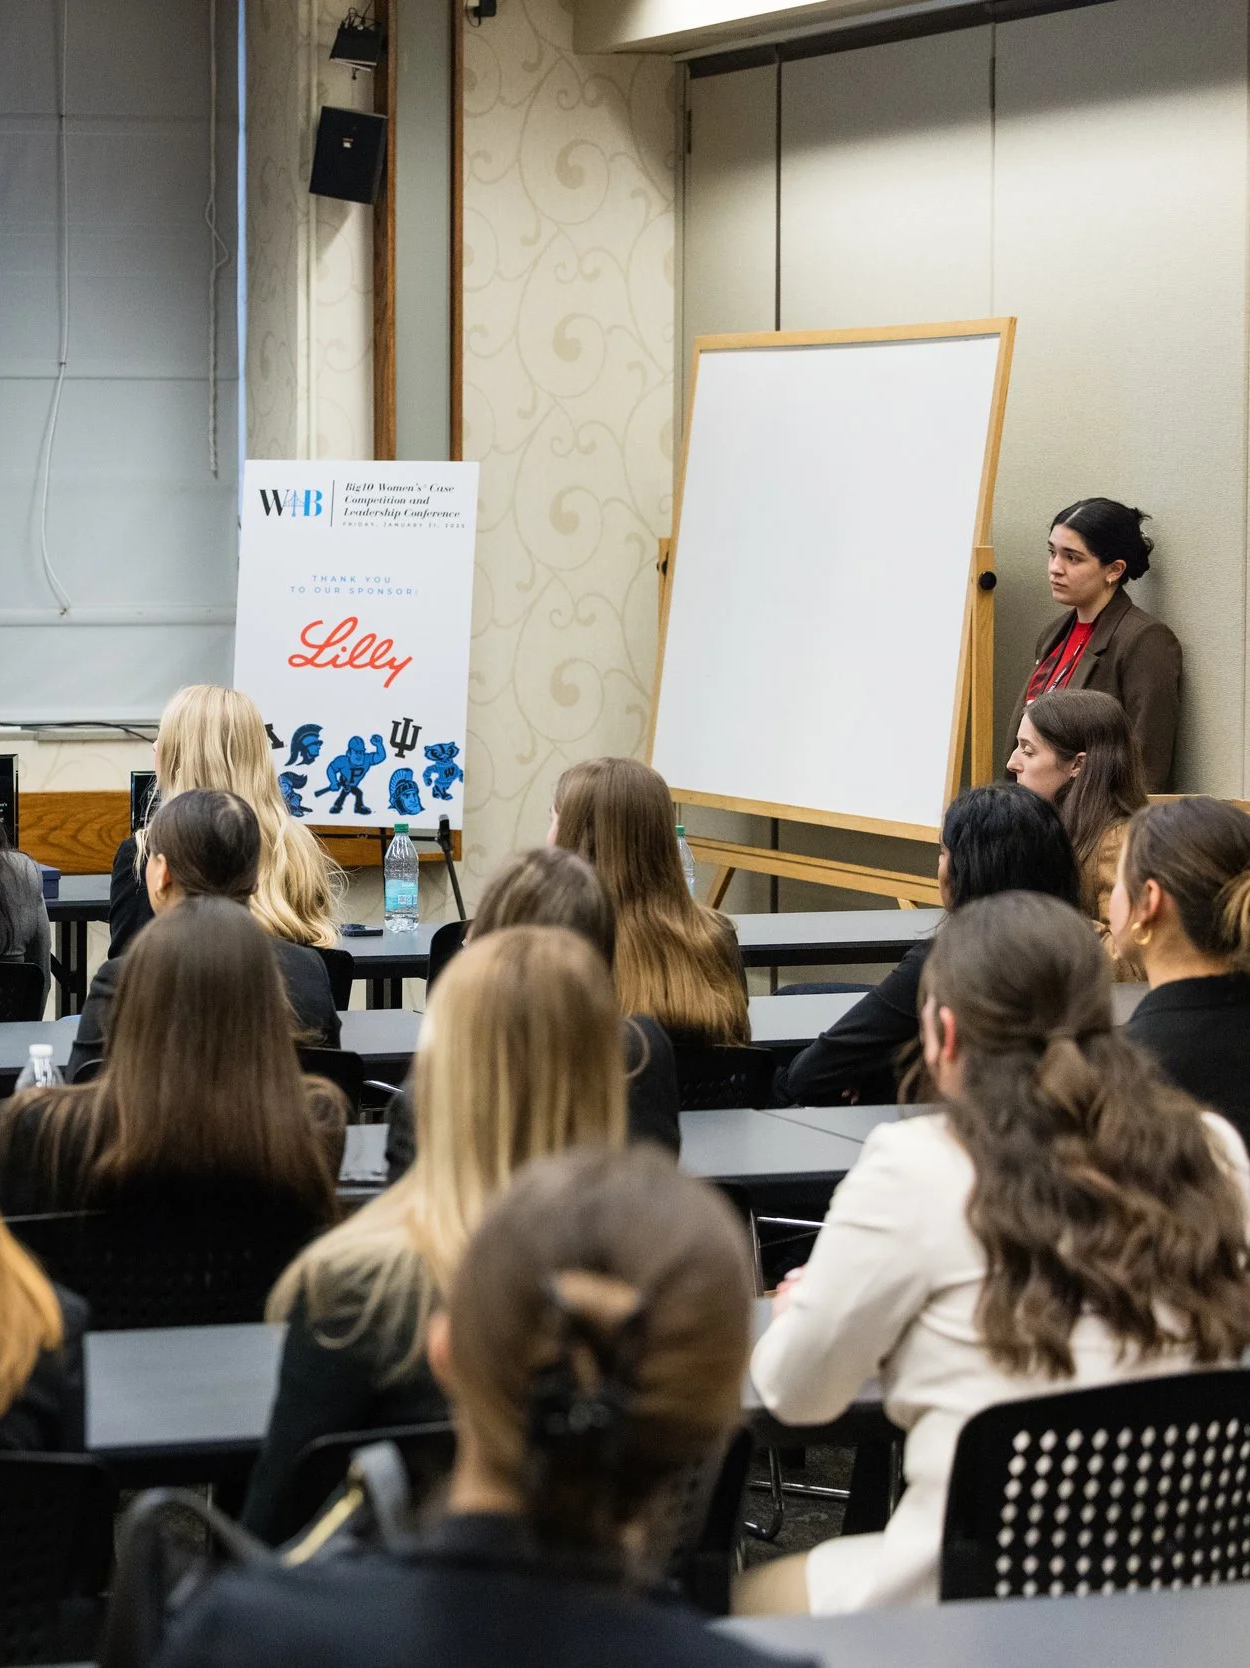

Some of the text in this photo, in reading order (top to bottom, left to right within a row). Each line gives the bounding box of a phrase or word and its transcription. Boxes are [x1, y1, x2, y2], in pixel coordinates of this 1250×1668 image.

[345, 482, 375, 493] Big10
[429, 484, 455, 493] Case
[344, 494, 431, 507] Competition and
[343, 507, 461, 520] Leadership Conference
[312, 575, 392, 584] THANK YOU
[290, 586, 419, 596] TO OUR SPONSOR:
[287, 616, 413, 689] Lilly
